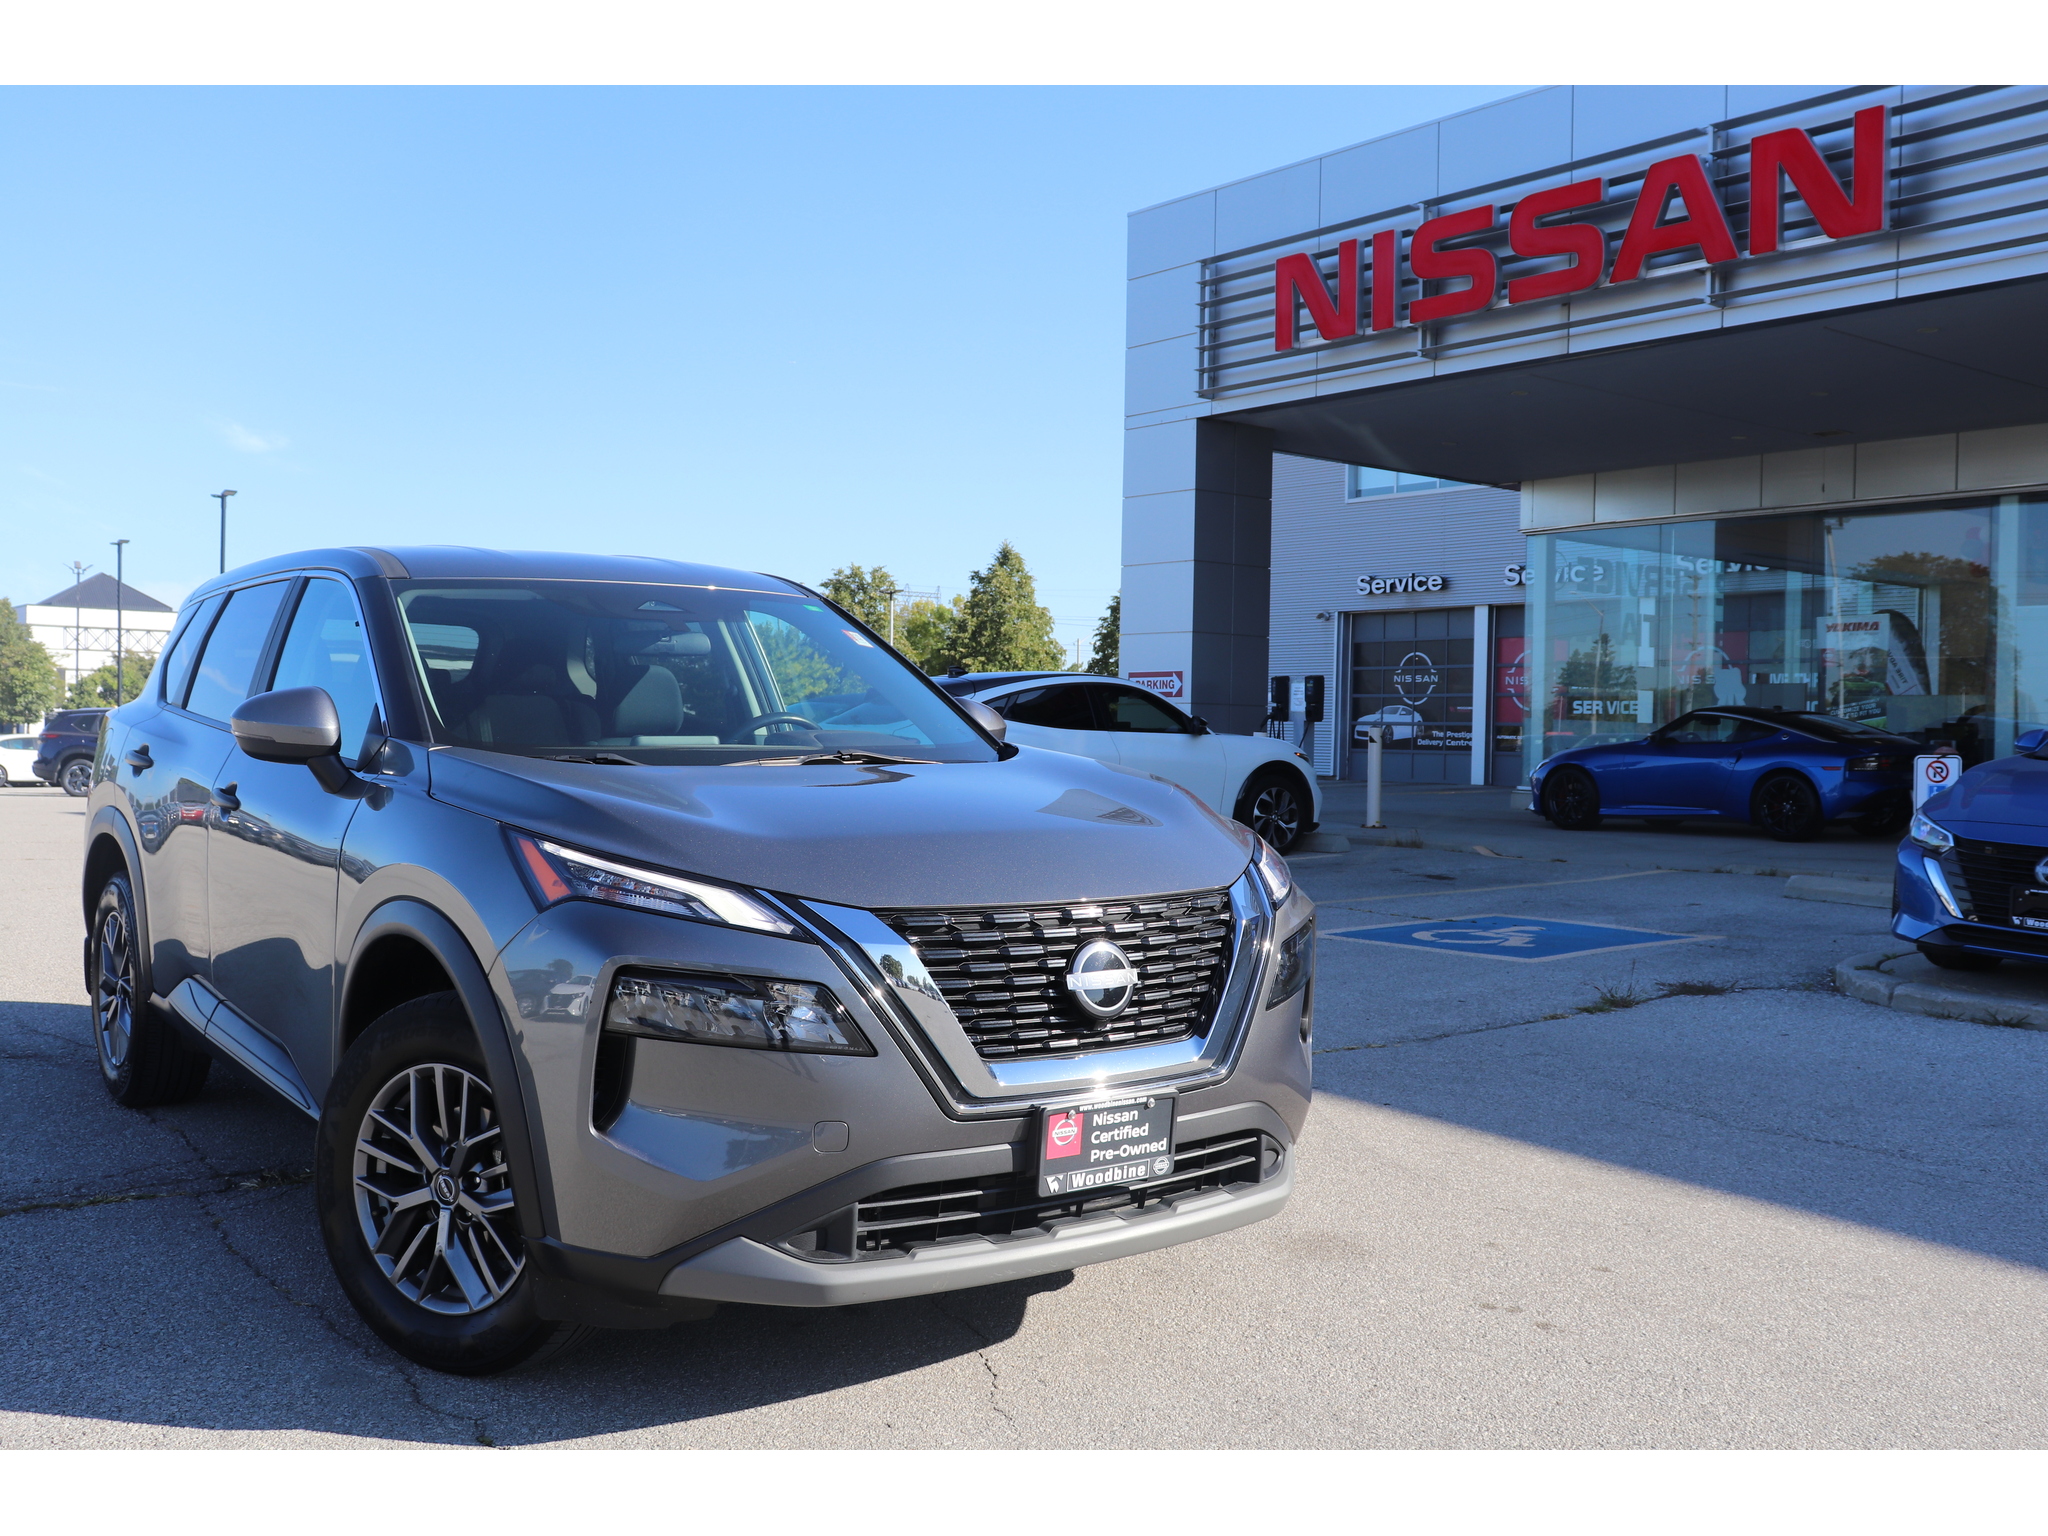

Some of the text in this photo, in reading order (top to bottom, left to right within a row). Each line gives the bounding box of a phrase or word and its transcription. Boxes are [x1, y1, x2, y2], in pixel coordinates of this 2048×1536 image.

[1275, 104, 1888, 351] NISSAN
[1504, 563, 1604, 587] Sevice
[1356, 573, 1444, 595] Service
[1826, 621, 1880, 633] YAKIMA
[1393, 674, 1439, 683] NISSAN
[1505, 676, 1529, 685] NIS
[1417, 739, 1444, 747] Delivery
[1070, 973, 1136, 988] NISSAN
[1079, 1097, 1148, 1112] www.woodbinenissan.com
[1092, 1109, 1139, 1127] Nissan
[1053, 1128, 1077, 1136] NISSAN
[1091, 1123, 1149, 1144] Certified
[1090, 1138, 1167, 1163] Pre-Owned
[1071, 1163, 1146, 1188] Woodbine
